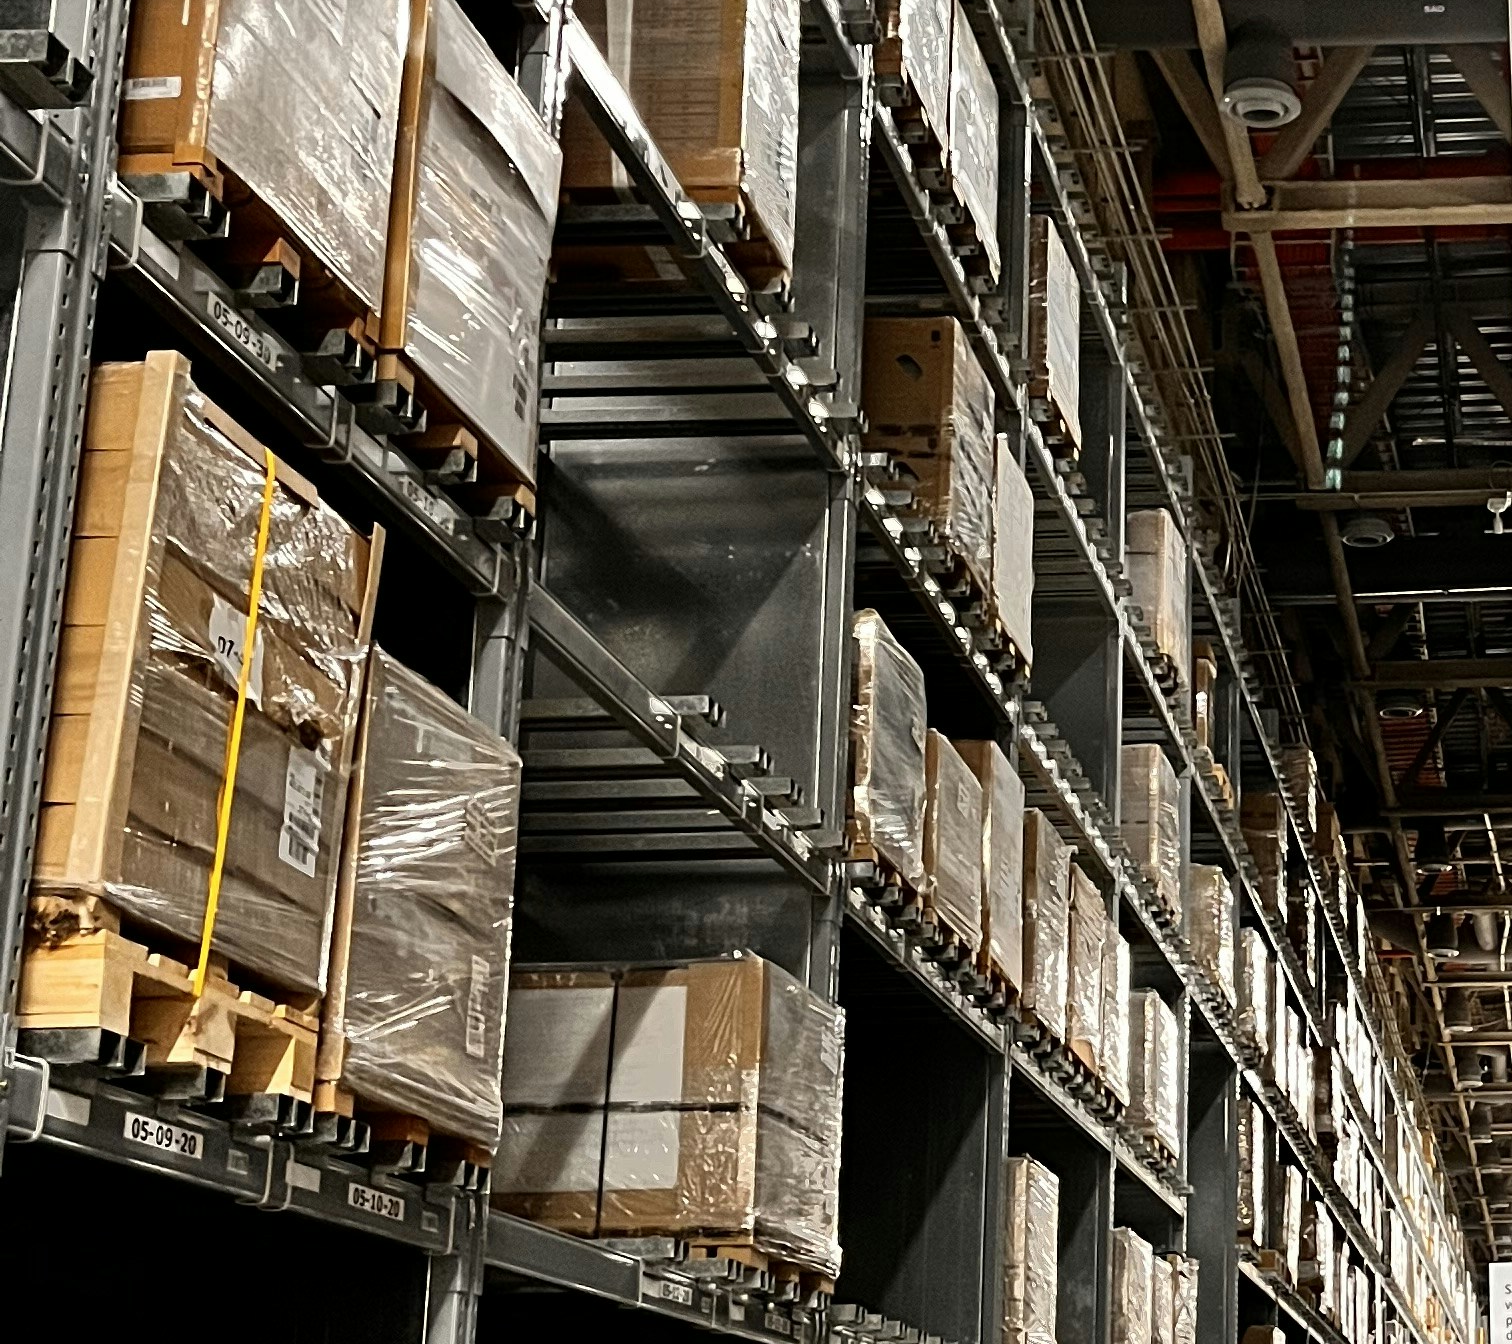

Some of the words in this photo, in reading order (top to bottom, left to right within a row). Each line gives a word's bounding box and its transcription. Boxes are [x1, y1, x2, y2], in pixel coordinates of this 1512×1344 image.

[213, 300, 271, 365] 05-09-30
[131, 1116, 197, 1156] 05-09-20
[352, 1186, 400, 1219] 05-10-20
